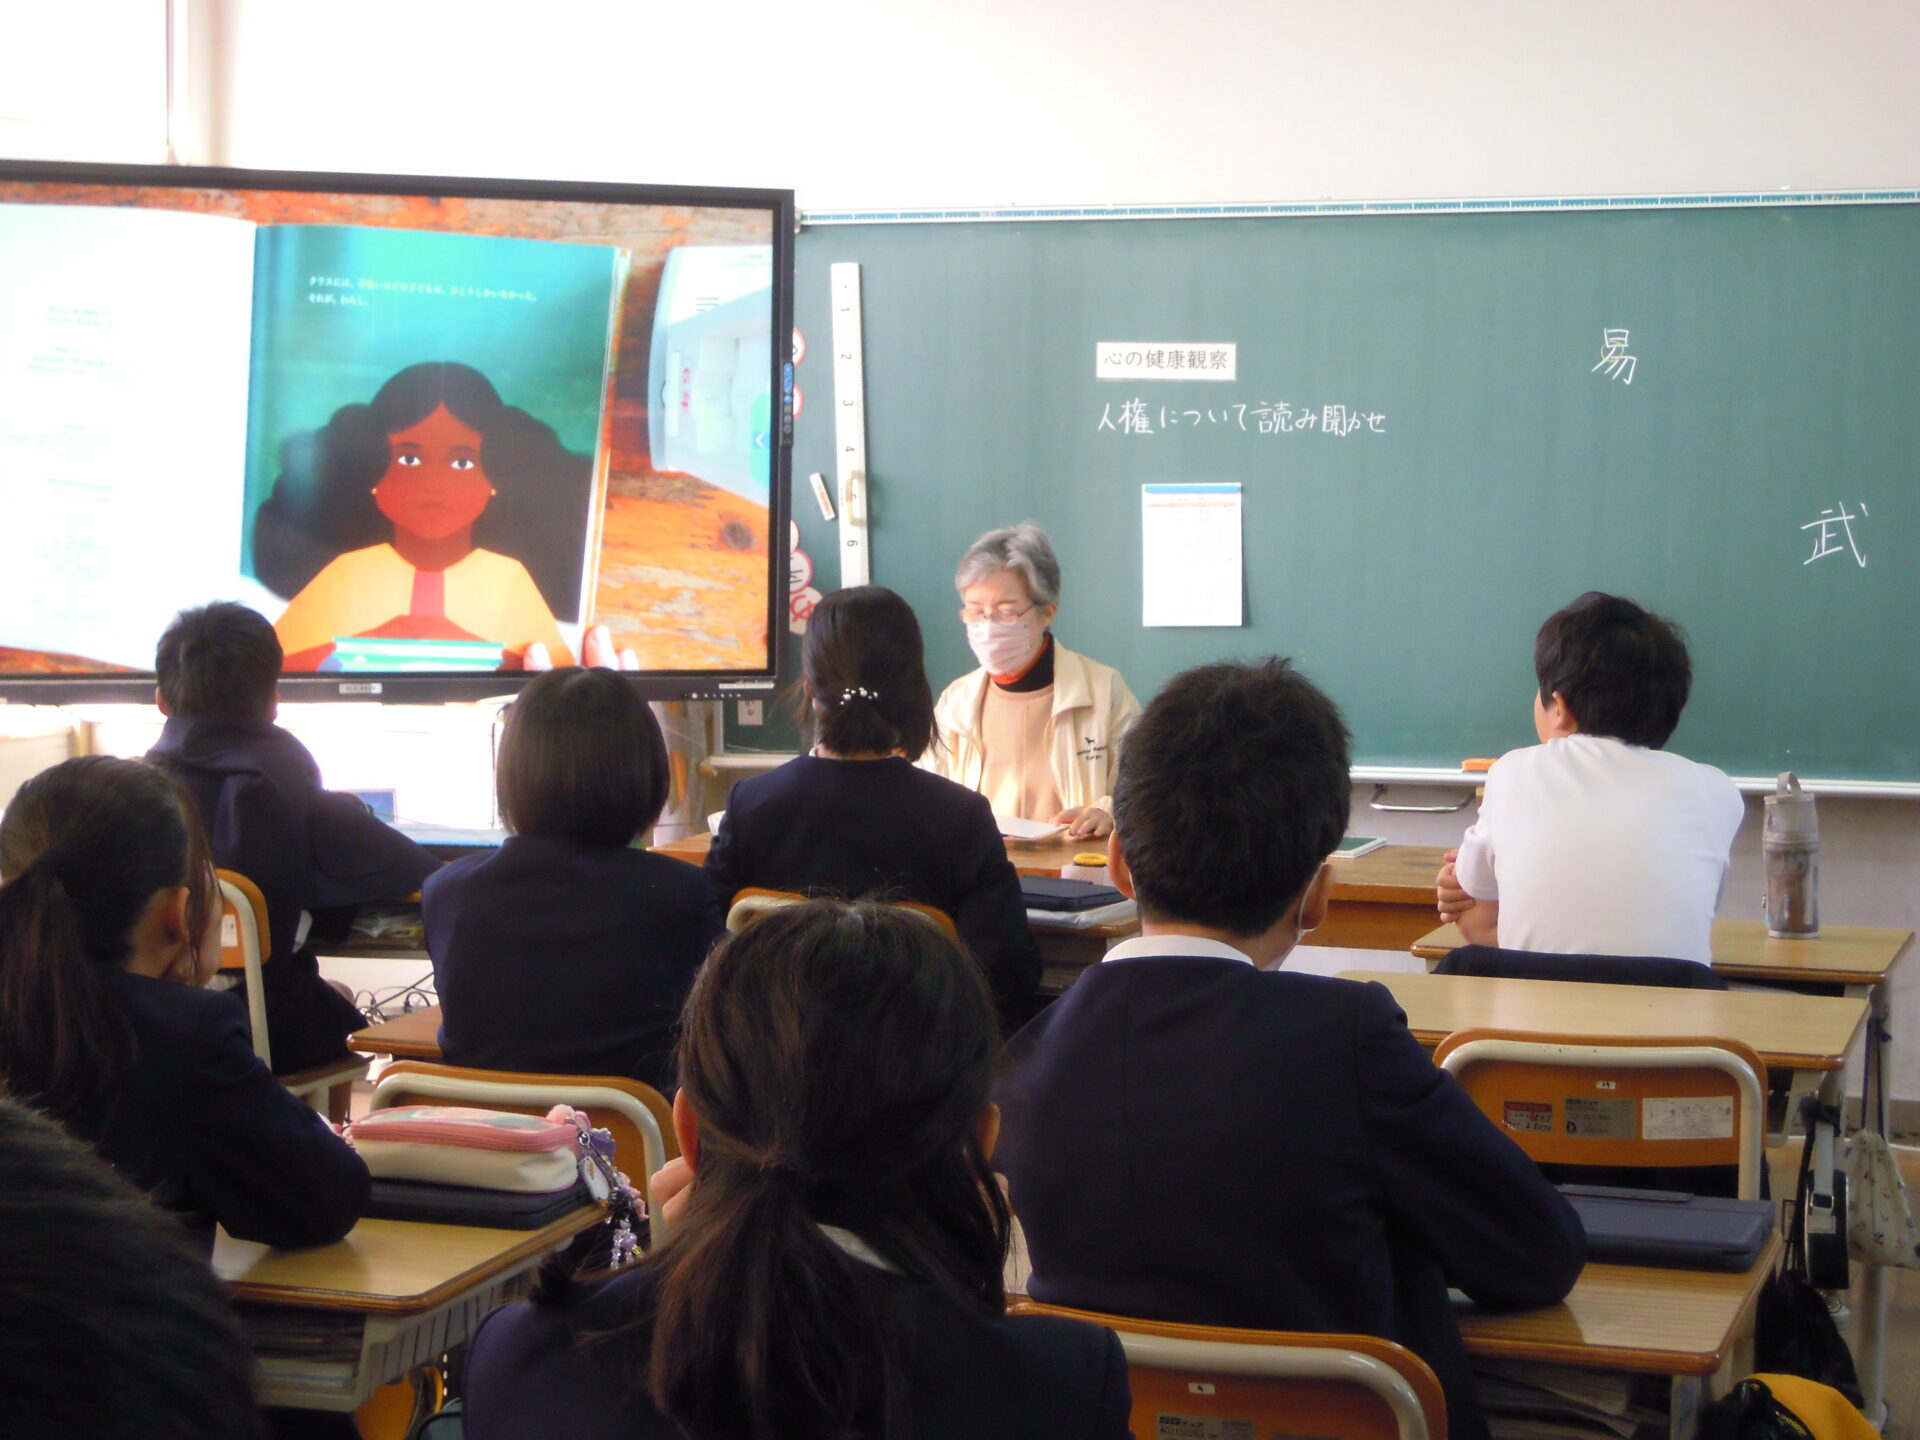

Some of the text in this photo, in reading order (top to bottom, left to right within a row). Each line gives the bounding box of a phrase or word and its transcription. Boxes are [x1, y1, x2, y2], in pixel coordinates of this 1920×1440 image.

[1104, 349, 1228, 370] 心の健康観察
[1592, 328, 1637, 385] 易
[1097, 397, 1386, 437] 人権について読み聞かせ
[841, 353, 853, 361] 2
[847, 539, 858, 547] 6
[1801, 501, 1868, 567] 武
